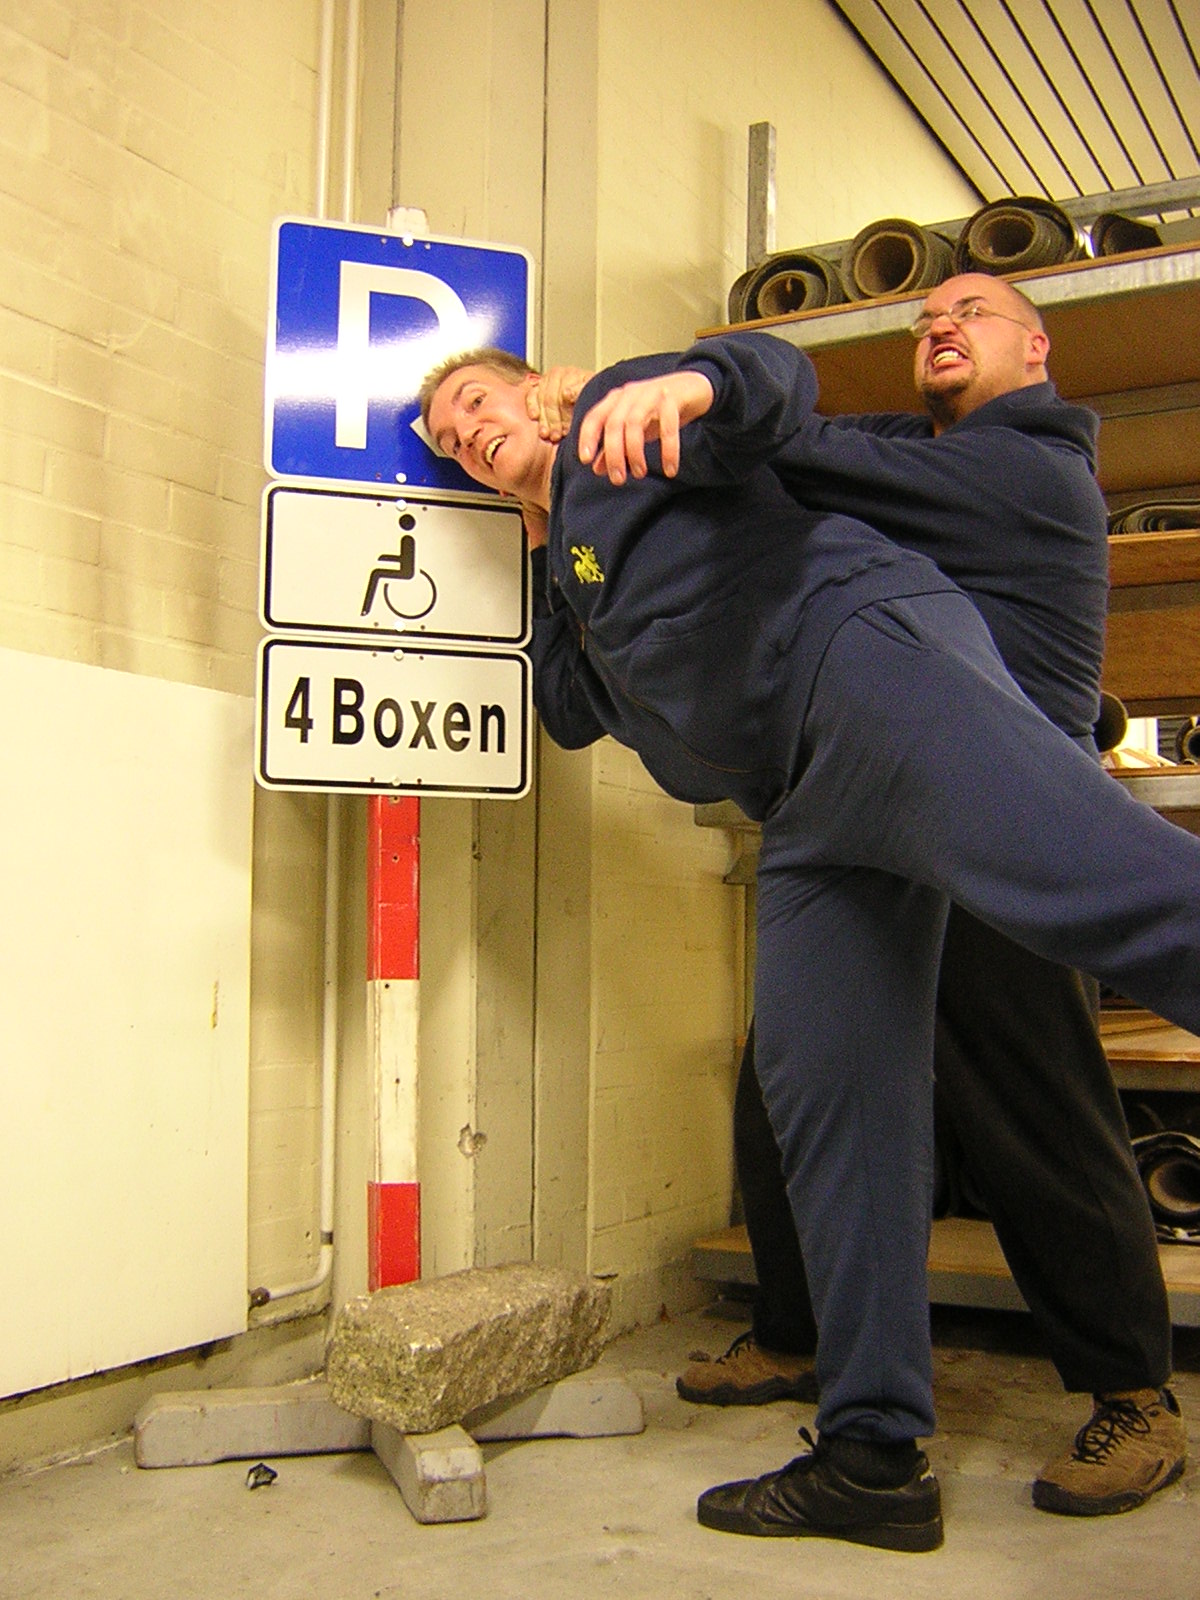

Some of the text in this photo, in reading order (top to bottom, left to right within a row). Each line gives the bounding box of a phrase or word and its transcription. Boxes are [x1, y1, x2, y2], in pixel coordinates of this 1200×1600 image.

[335, 260, 474, 450] P
[284, 676, 506, 754] 4 Boxen
